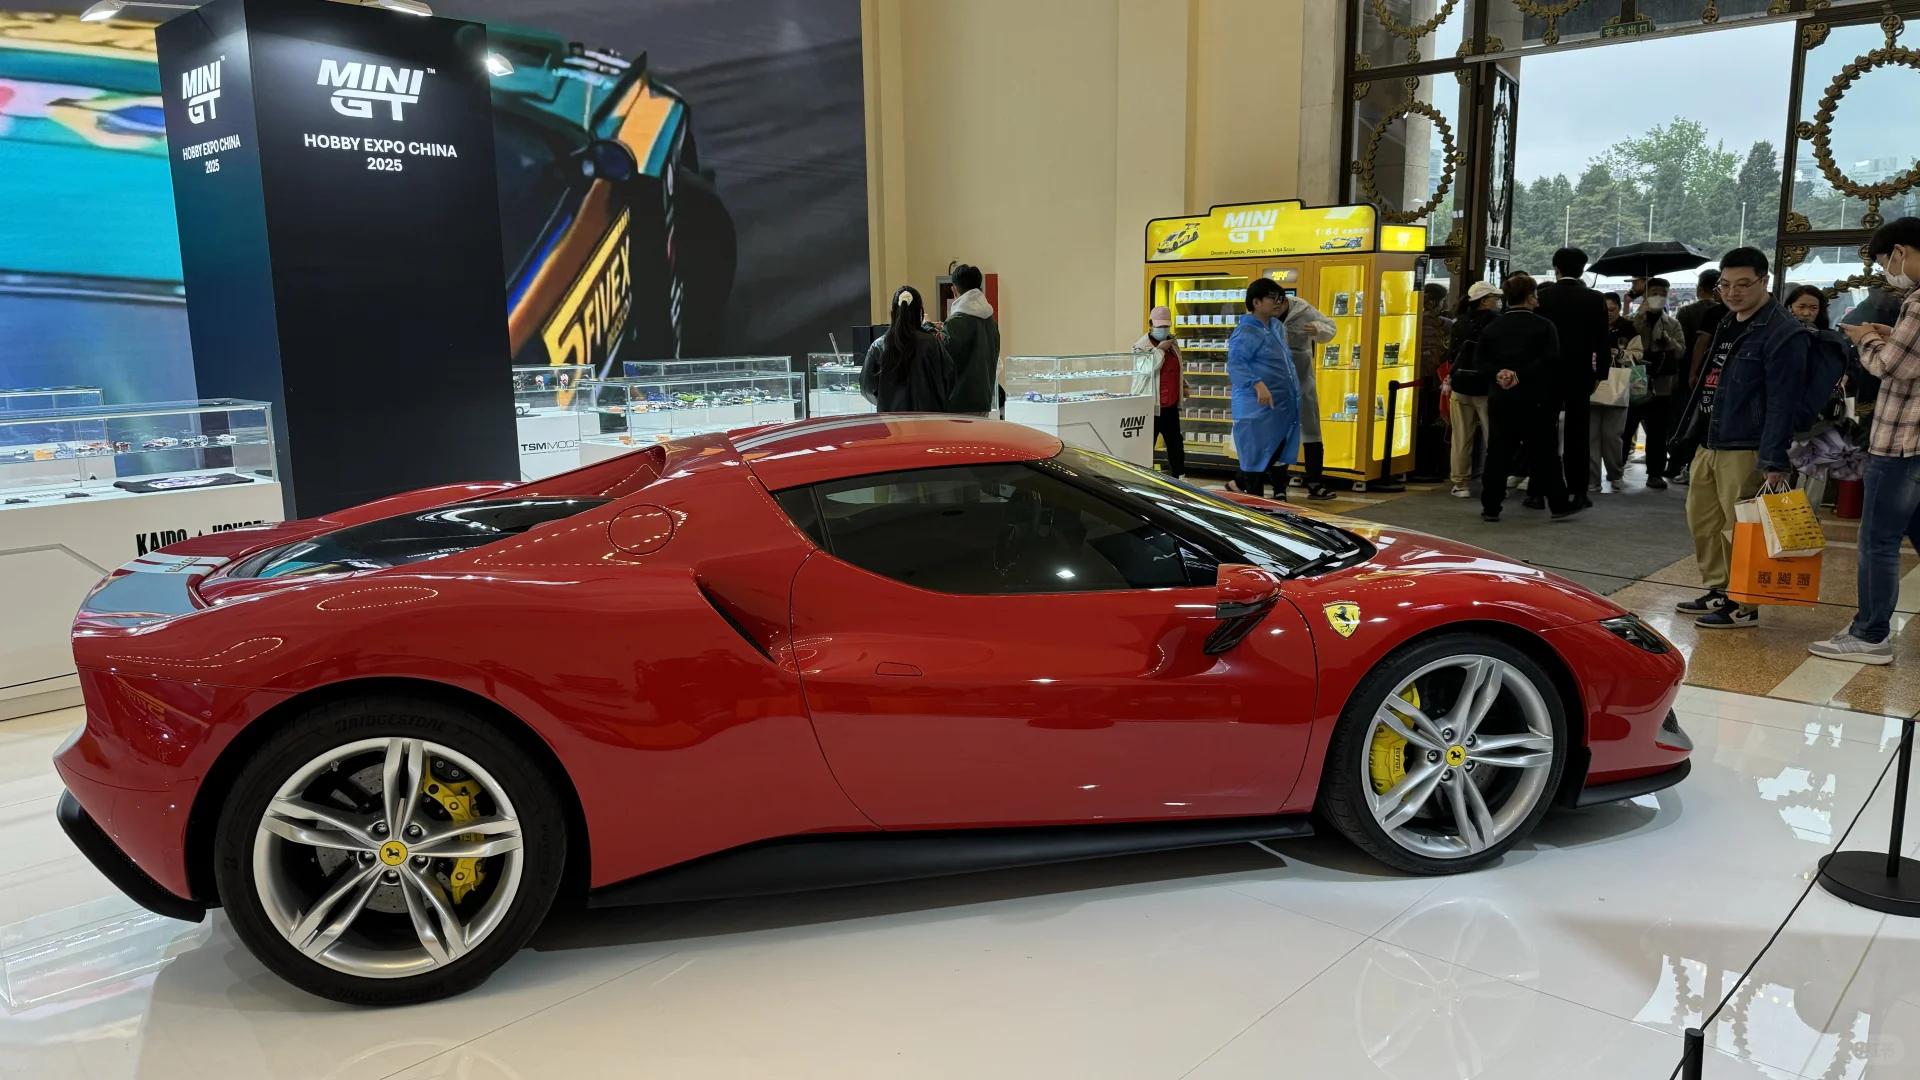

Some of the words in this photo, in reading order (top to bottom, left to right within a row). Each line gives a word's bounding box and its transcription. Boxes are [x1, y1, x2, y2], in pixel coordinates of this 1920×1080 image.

[1605, 24, 1648, 39] 安全出口
[182, 60, 221, 99] MINI
[317, 58, 424, 95] MINI
[188, 89, 221, 124] GT
[330, 89, 418, 121] GT
[183, 144, 203, 161] HOBBY
[202, 139, 220, 156] EXPO
[219, 134, 241, 152] CHINA
[304, 133, 361, 151] HOBBY
[364, 138, 405, 154] EXPO
[408, 141, 458, 158] CHINA
[205, 159, 220, 174] 2025
[367, 157, 403, 172] 2025
[1224, 210, 1278, 229] MINI
[1228, 225, 1274, 243] GT
[1315, 228, 1339, 237] 1:64
[1120, 415, 1146, 428] MINI
[1123, 426, 1144, 438] GT
[334, 713, 448, 734] BRIDGESTONE
